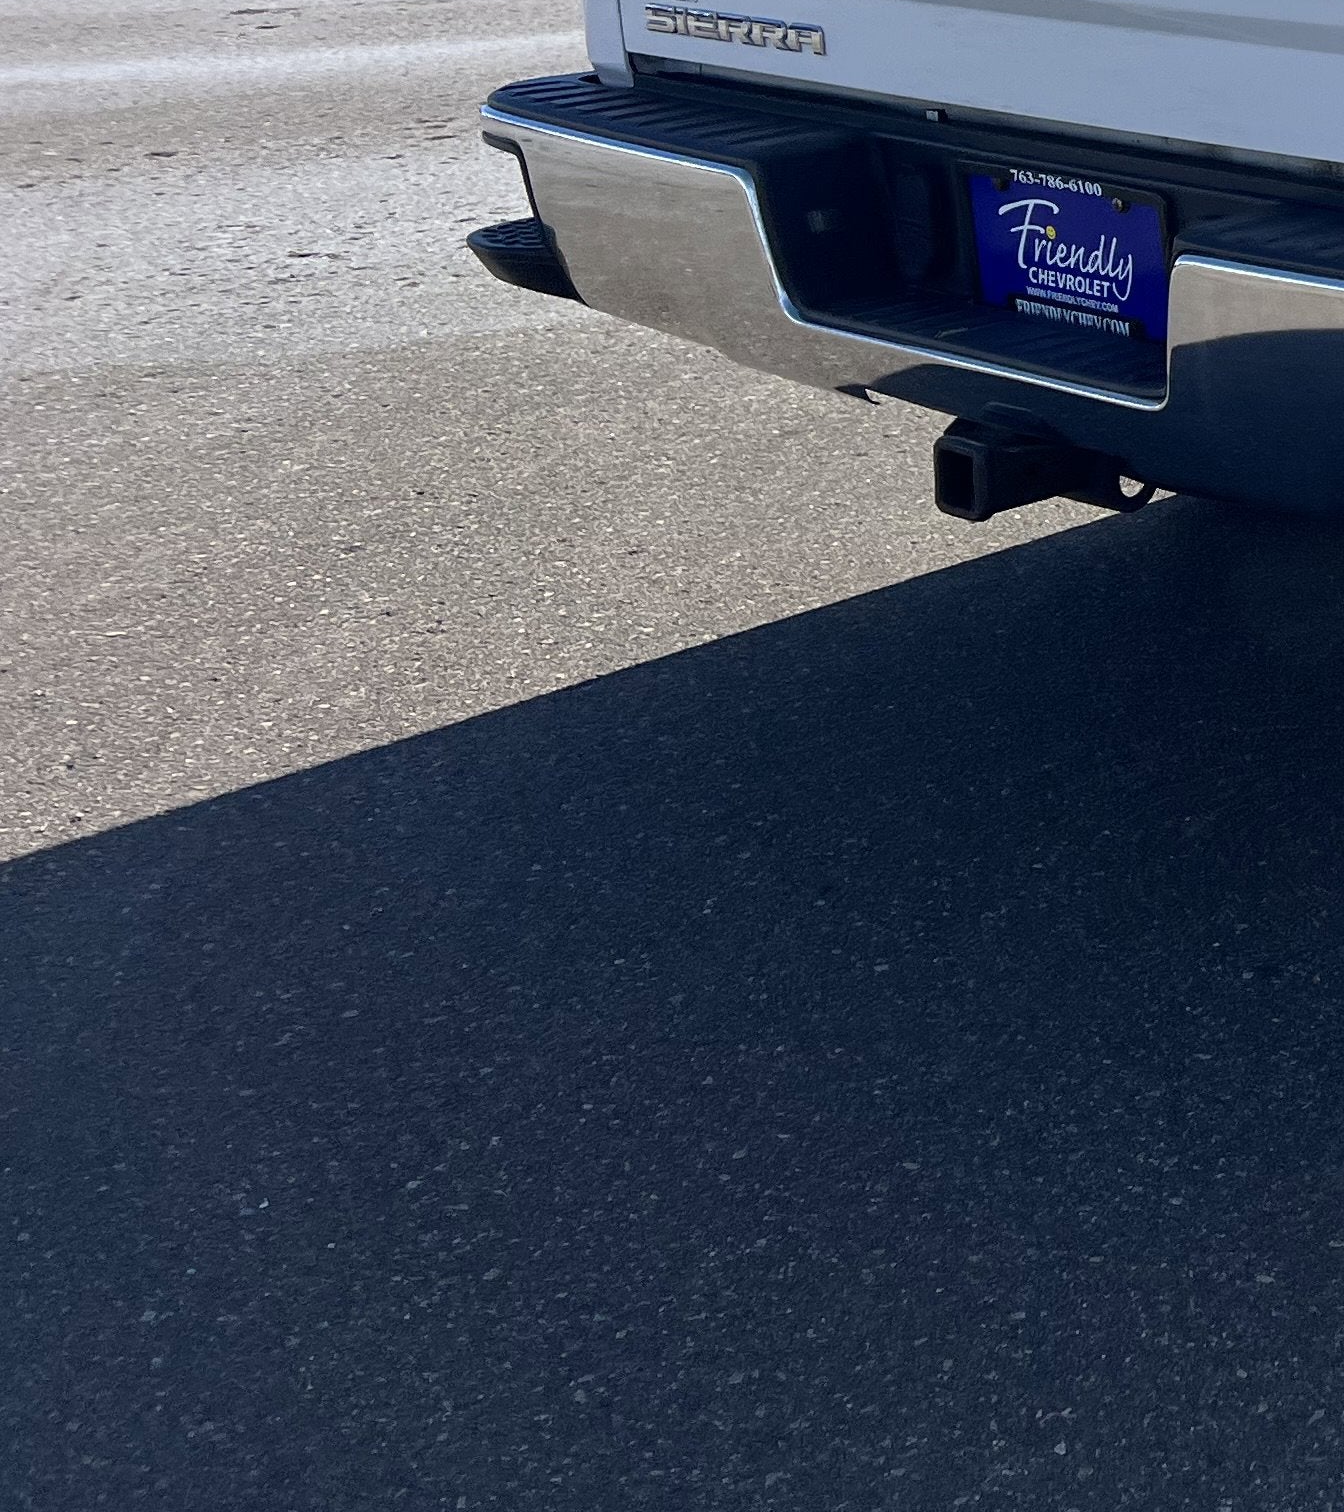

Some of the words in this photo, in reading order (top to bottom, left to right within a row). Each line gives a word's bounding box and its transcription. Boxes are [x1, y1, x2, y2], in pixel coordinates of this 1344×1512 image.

[645, 3, 827, 56] SIERRA
[1009, 168, 1102, 196] 763-786-6100
[998, 199, 1133, 300] Friendly
[1028, 266, 1110, 298] CHEVROLET
